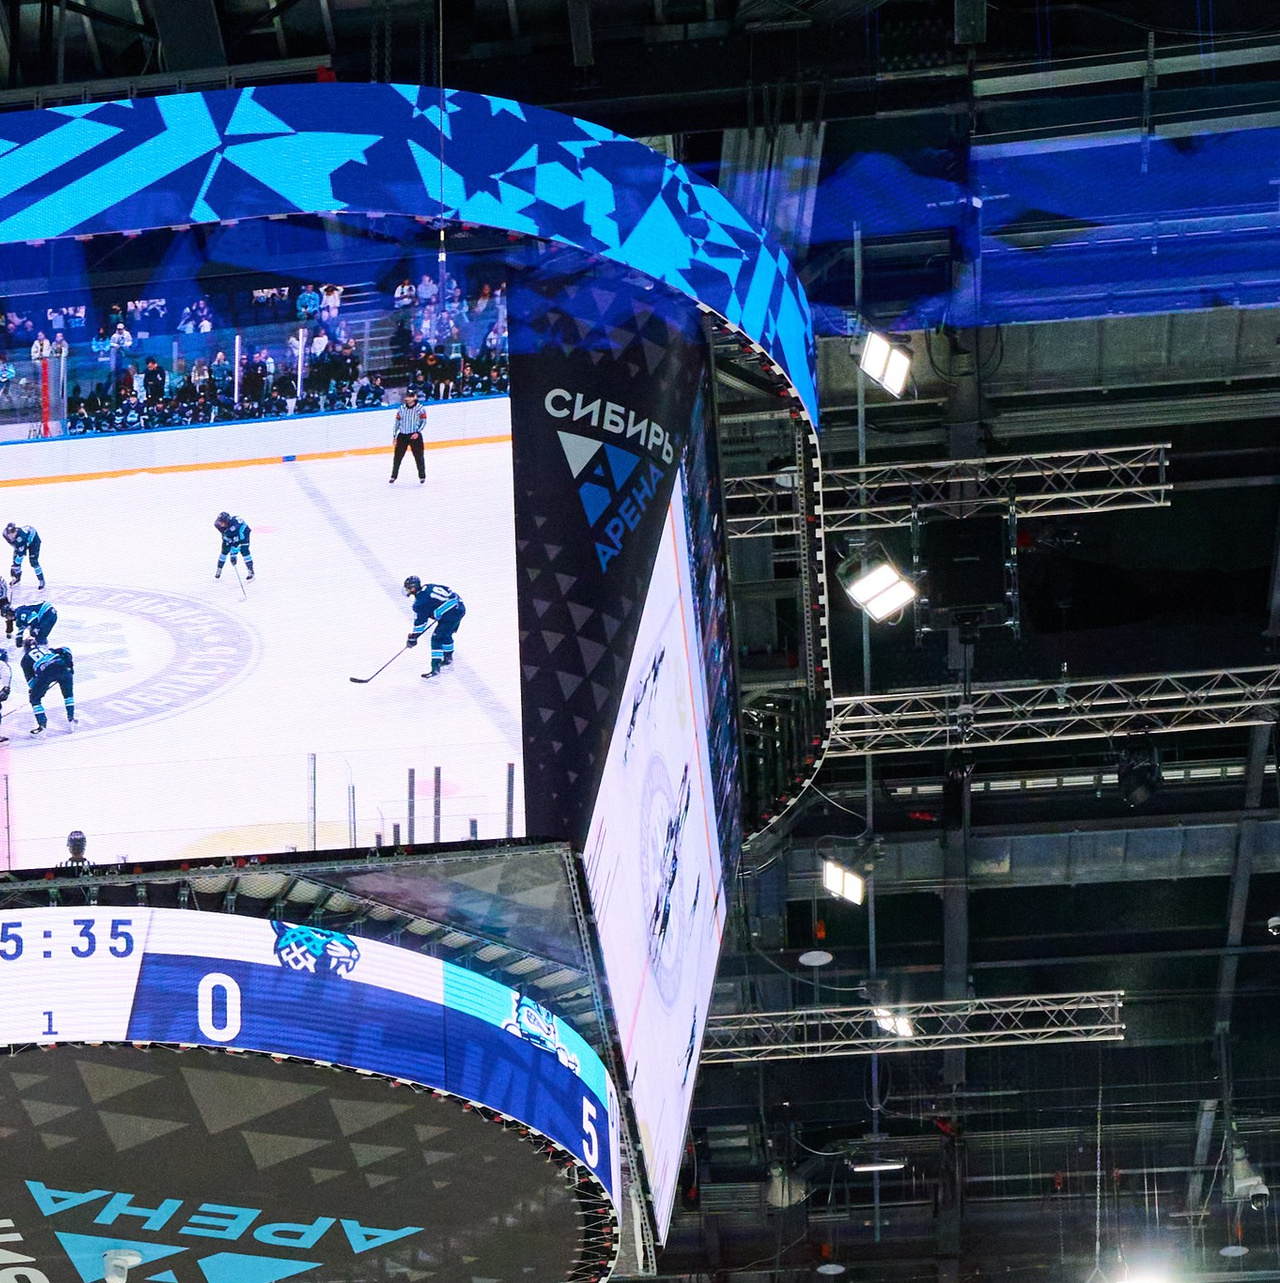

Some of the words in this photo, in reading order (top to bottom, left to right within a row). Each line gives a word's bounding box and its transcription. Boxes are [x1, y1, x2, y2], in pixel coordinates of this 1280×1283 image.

[544, 388, 674, 464] СИБИРЬ
[594, 462, 666, 575] АРЕНА
[43, 1011, 59, 1035] 1
[197, 972, 242, 1042] 0
[583, 1096, 599, 1168] 5
[25, 1180, 425, 1254] АРЕНА
